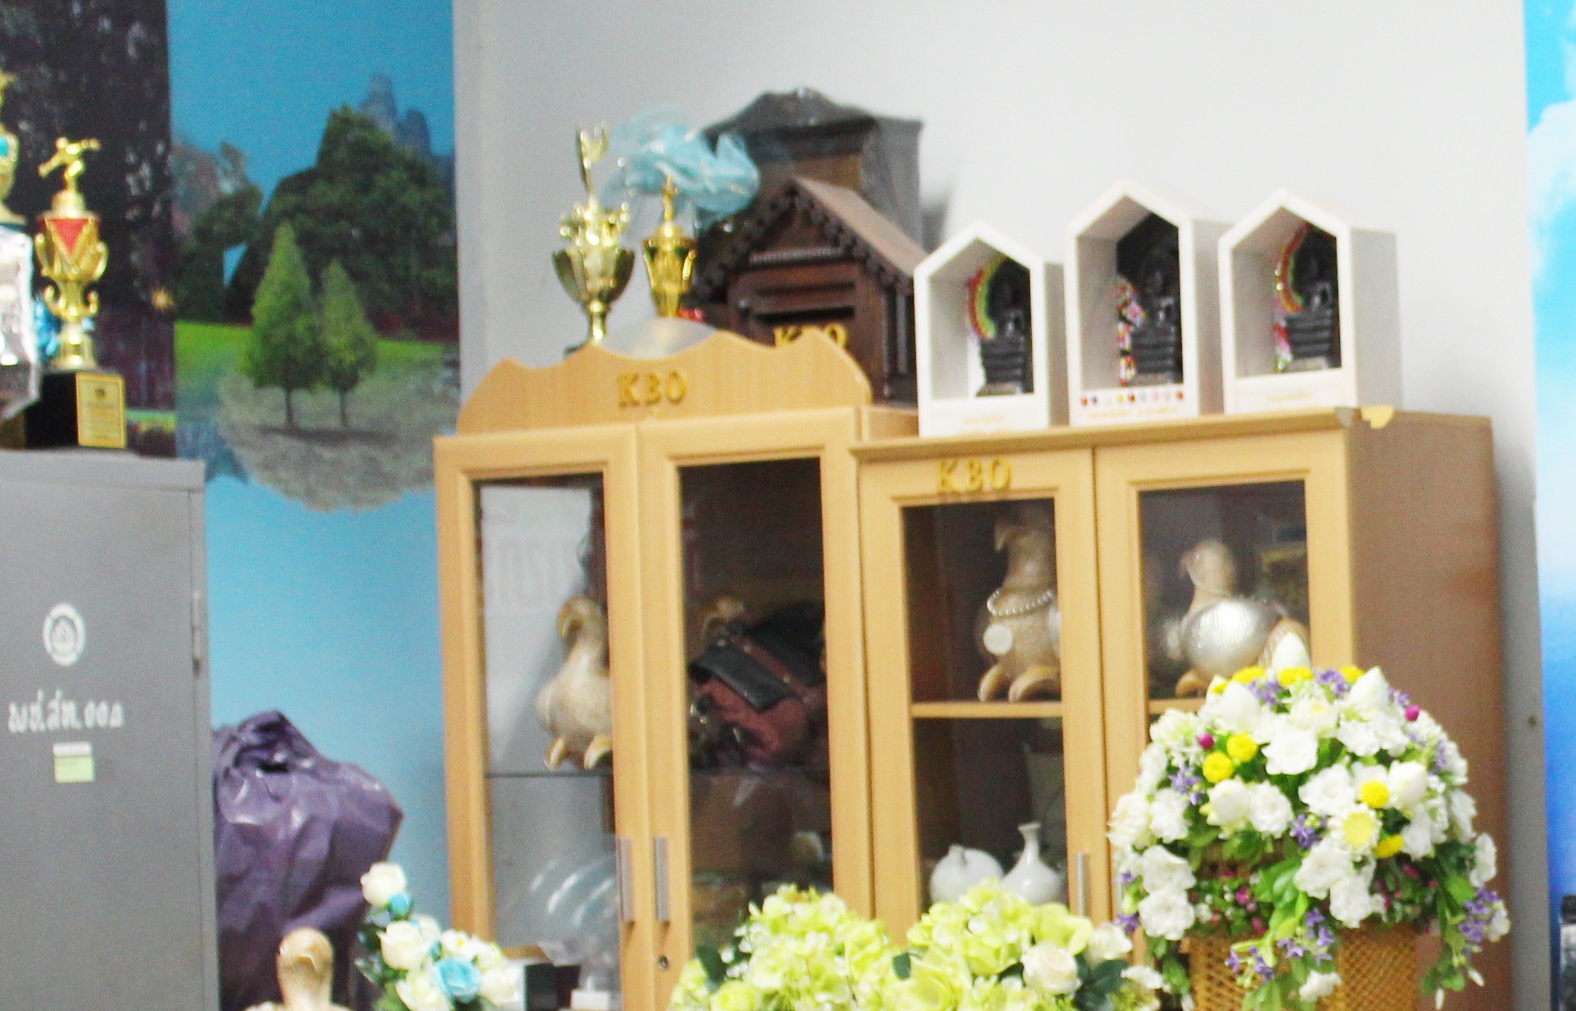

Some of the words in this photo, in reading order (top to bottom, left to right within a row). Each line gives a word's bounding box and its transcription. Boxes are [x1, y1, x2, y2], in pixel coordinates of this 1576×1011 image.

[774, 324, 848, 347] KO
[617, 371, 688, 406] KBO
[937, 457, 1011, 493] KBO
